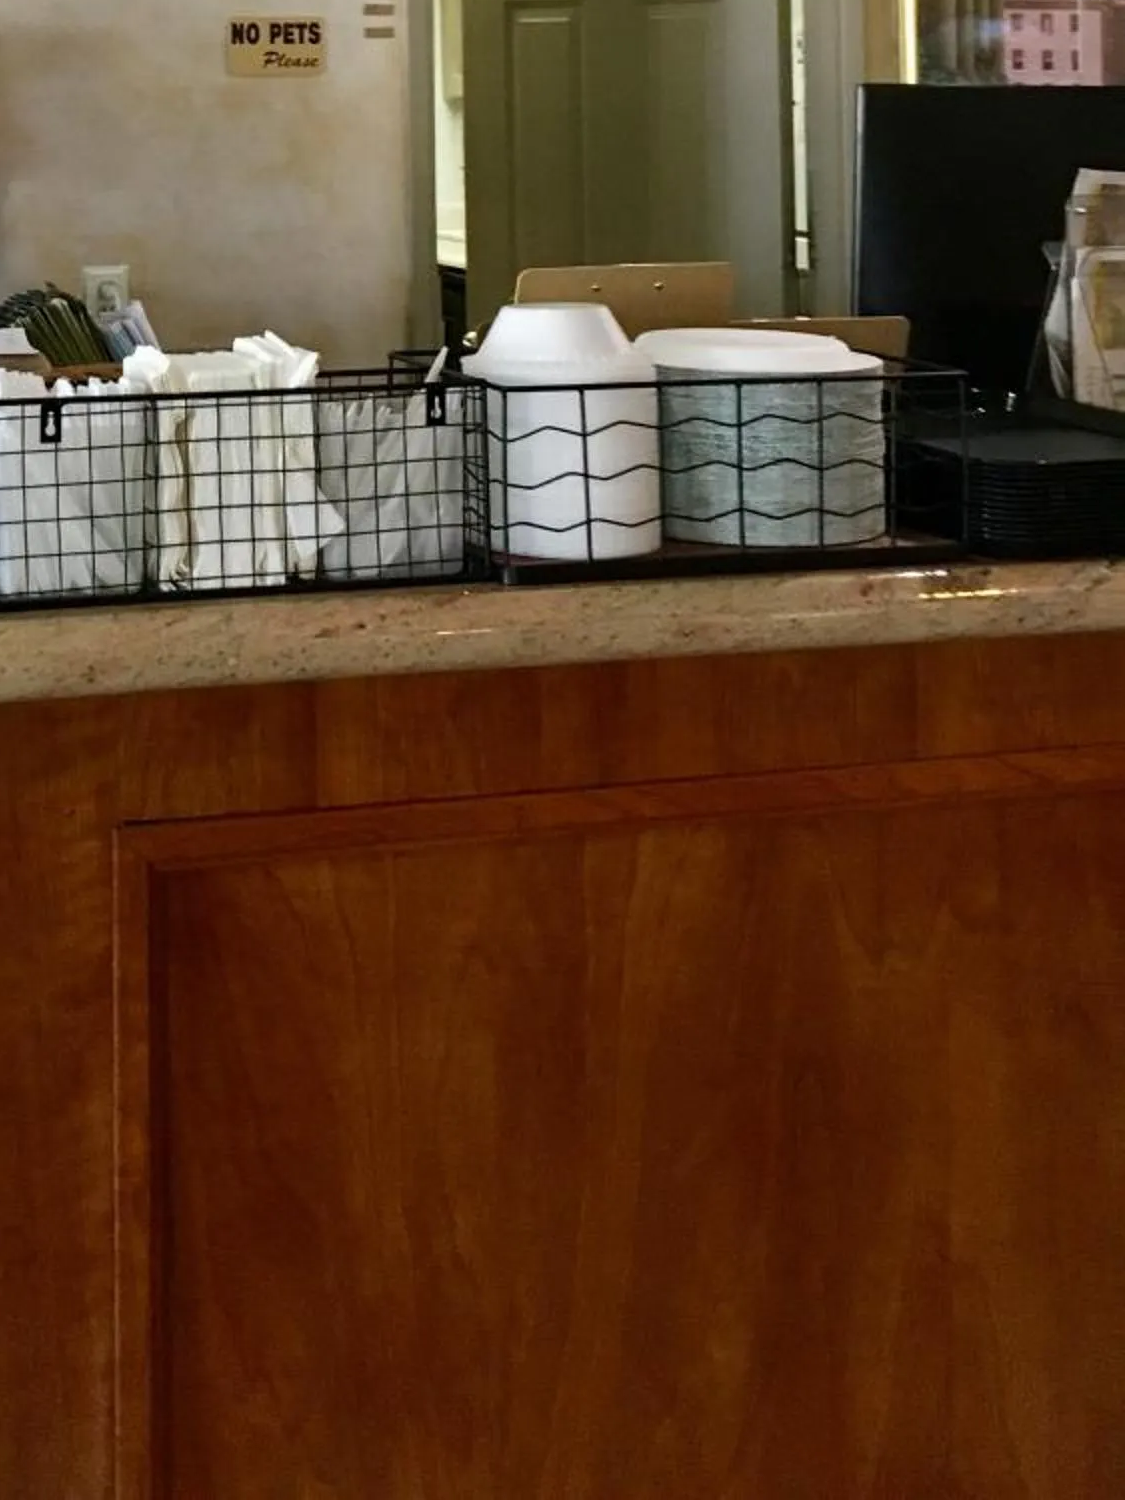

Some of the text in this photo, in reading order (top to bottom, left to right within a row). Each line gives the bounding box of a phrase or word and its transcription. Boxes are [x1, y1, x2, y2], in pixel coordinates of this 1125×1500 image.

[231, 22, 322, 45] NO PETS
[262, 51, 320, 68] Please
